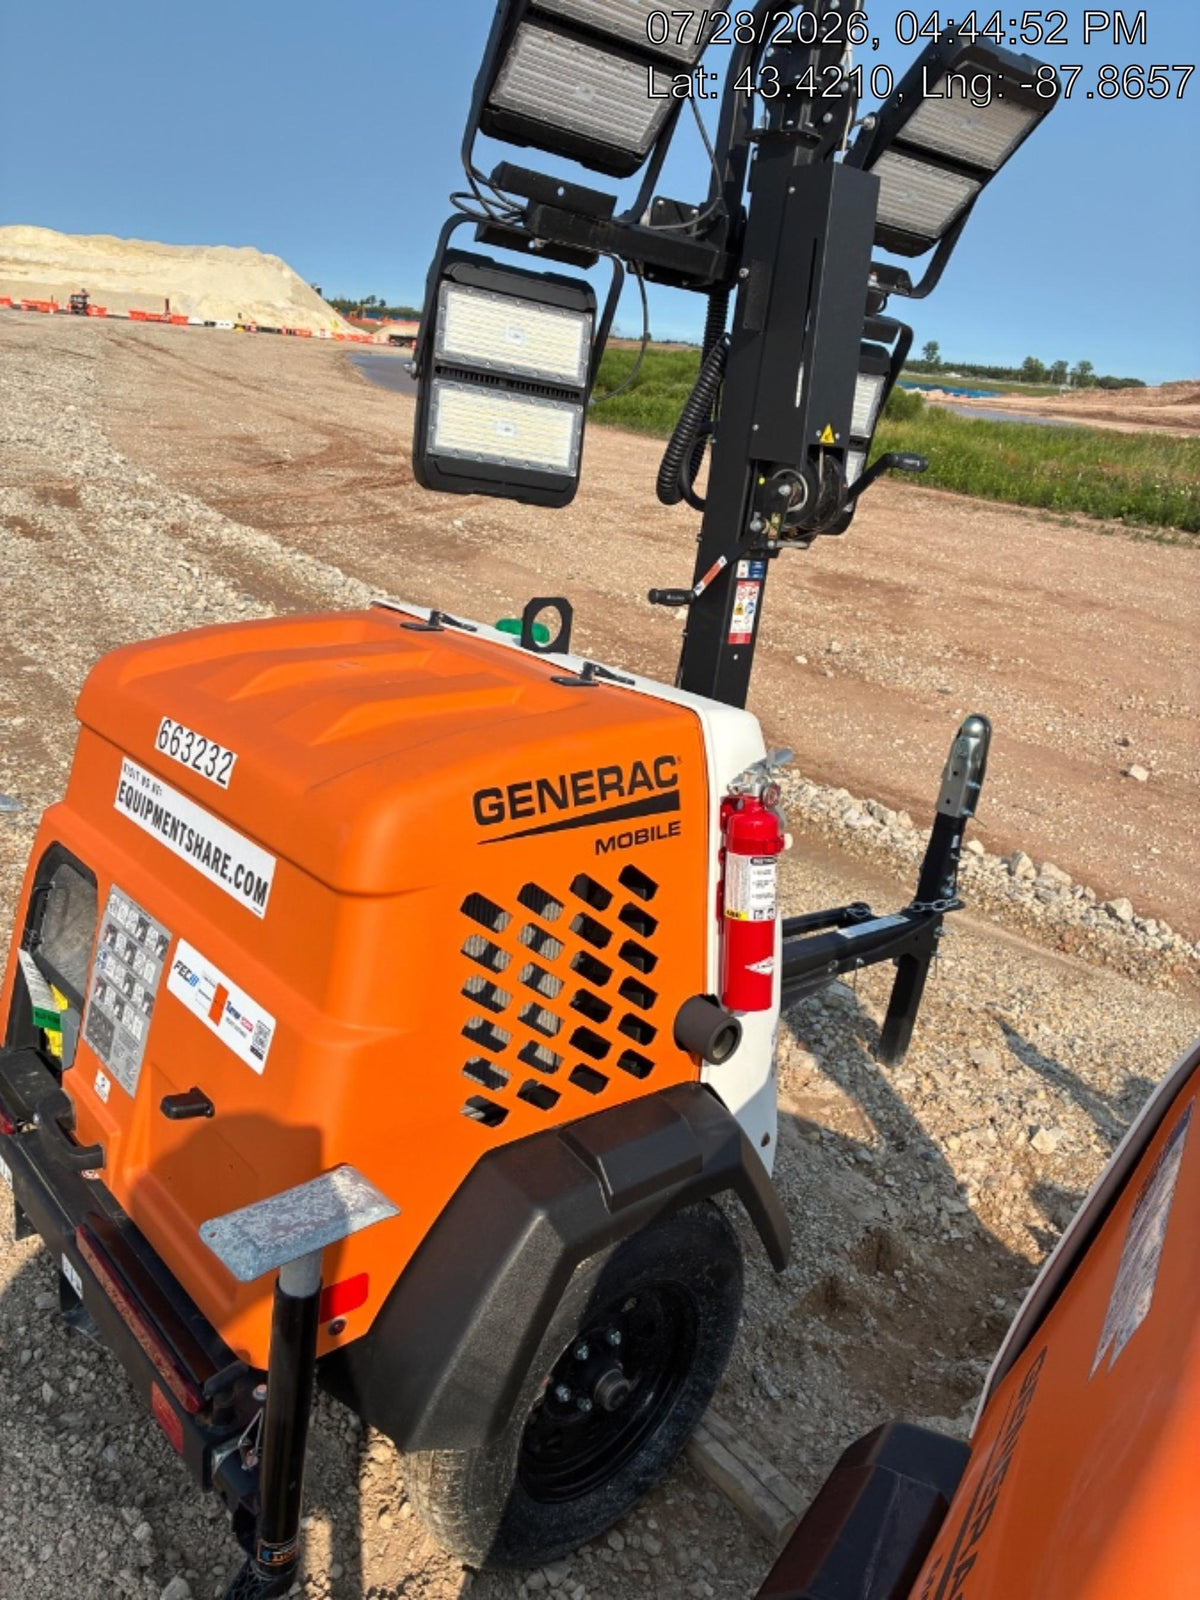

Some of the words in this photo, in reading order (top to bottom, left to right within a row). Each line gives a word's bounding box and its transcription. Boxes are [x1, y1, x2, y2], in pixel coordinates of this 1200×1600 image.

[157, 718, 234, 785] 663232
[472, 755, 679, 826] GENERAC
[117, 780, 269, 907] EQUIPMENTSHARE.COM
[594, 821, 682, 856] MOBILE
[950, 1345, 1048, 1600] GENERA
